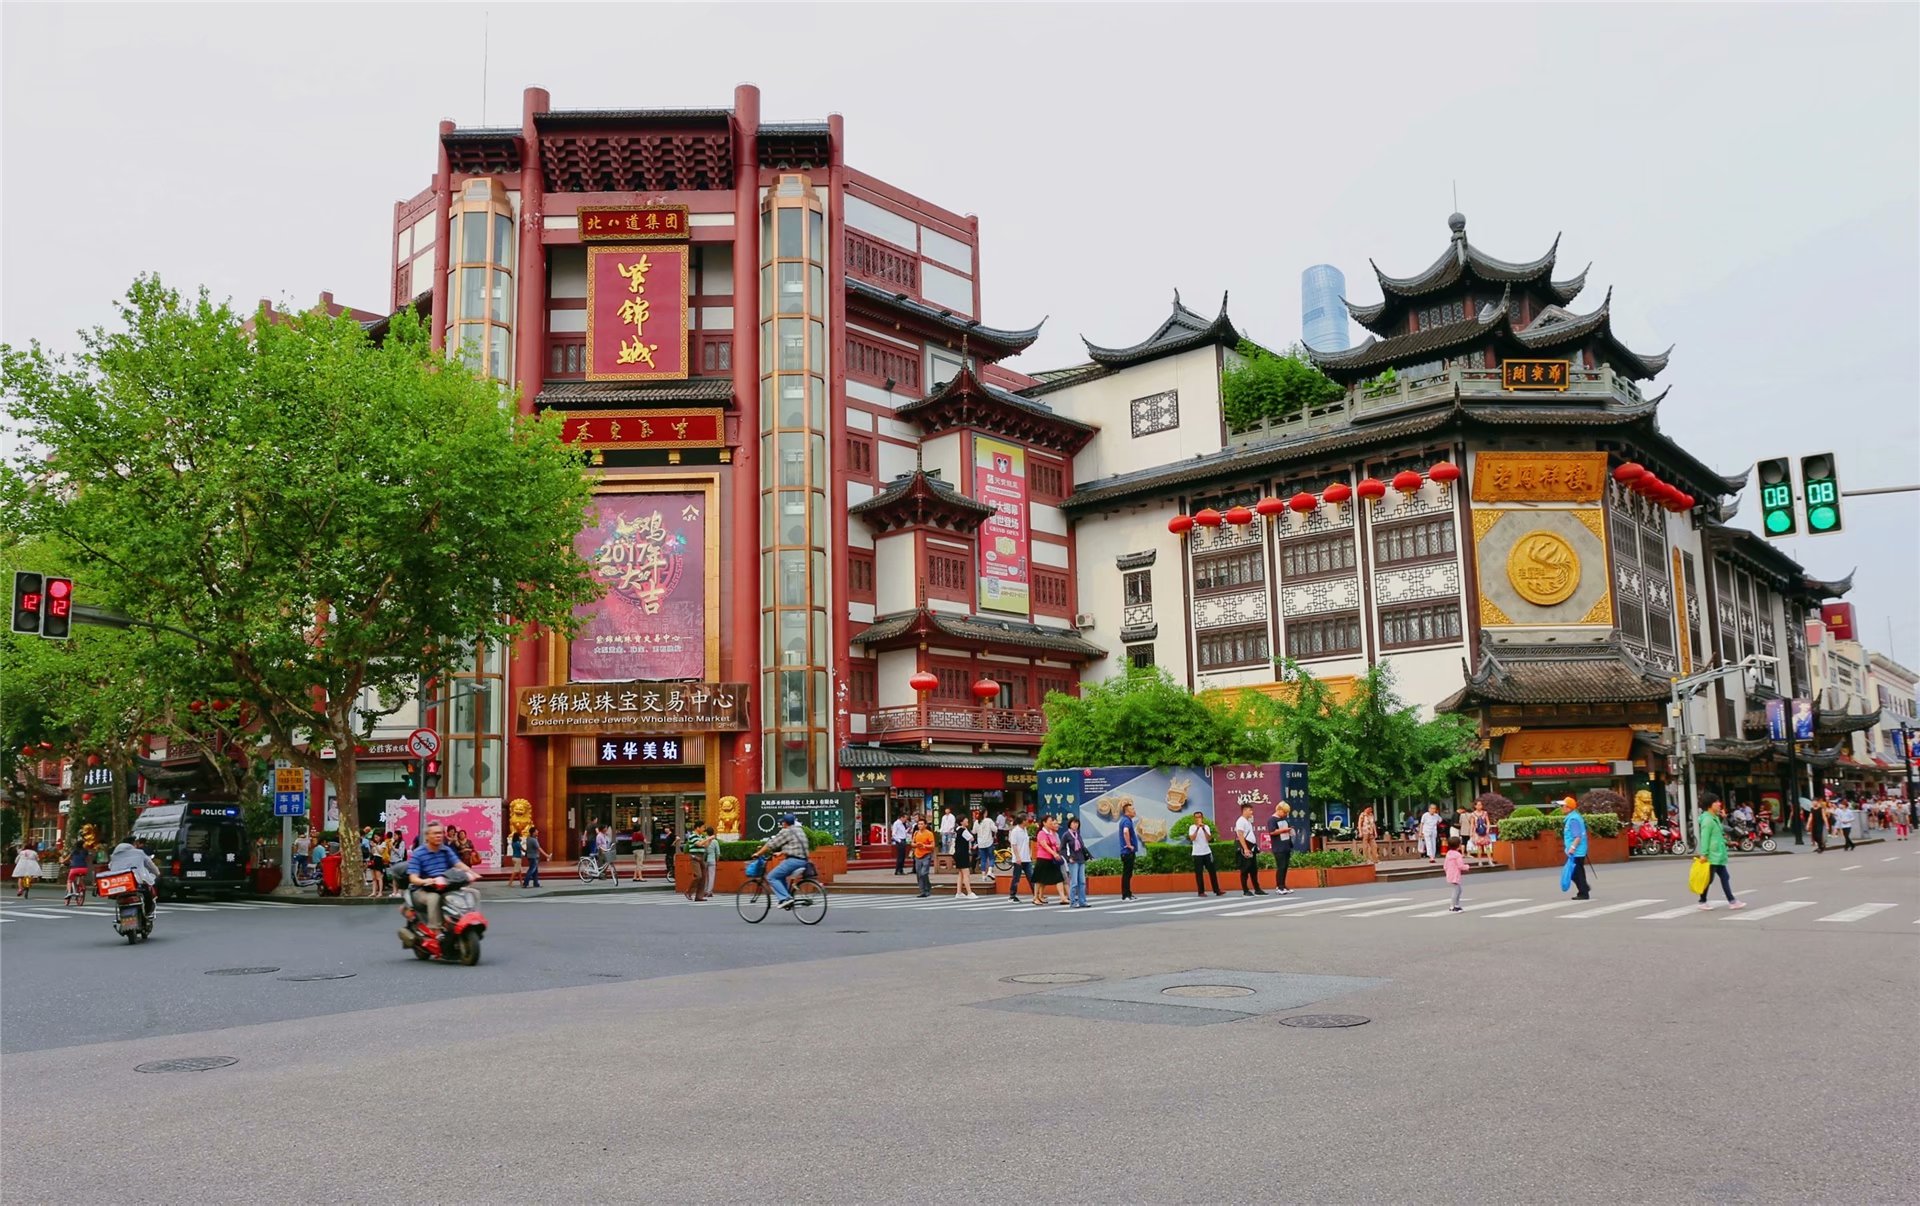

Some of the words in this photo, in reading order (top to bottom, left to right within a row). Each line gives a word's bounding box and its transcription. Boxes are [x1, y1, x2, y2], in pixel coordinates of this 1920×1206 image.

[587, 213, 678, 231] 北八道集团
[1764, 486, 1789, 508] 08
[1808, 482, 1834, 504] 08
[24, 595, 37, 610] 12
[53, 600, 67, 615] 12
[528, 691, 734, 716] 紫锦城珠宝交易中心
[531, 718, 564, 726] Golden
[566, 717, 600, 725] Palace
[602, 716, 639, 725] Jewelry
[641, 715, 693, 723] Wholesale
[696, 714, 730, 722] Market
[602, 741, 677, 761] 东华美钻
[201, 808, 226, 816] POLICE
